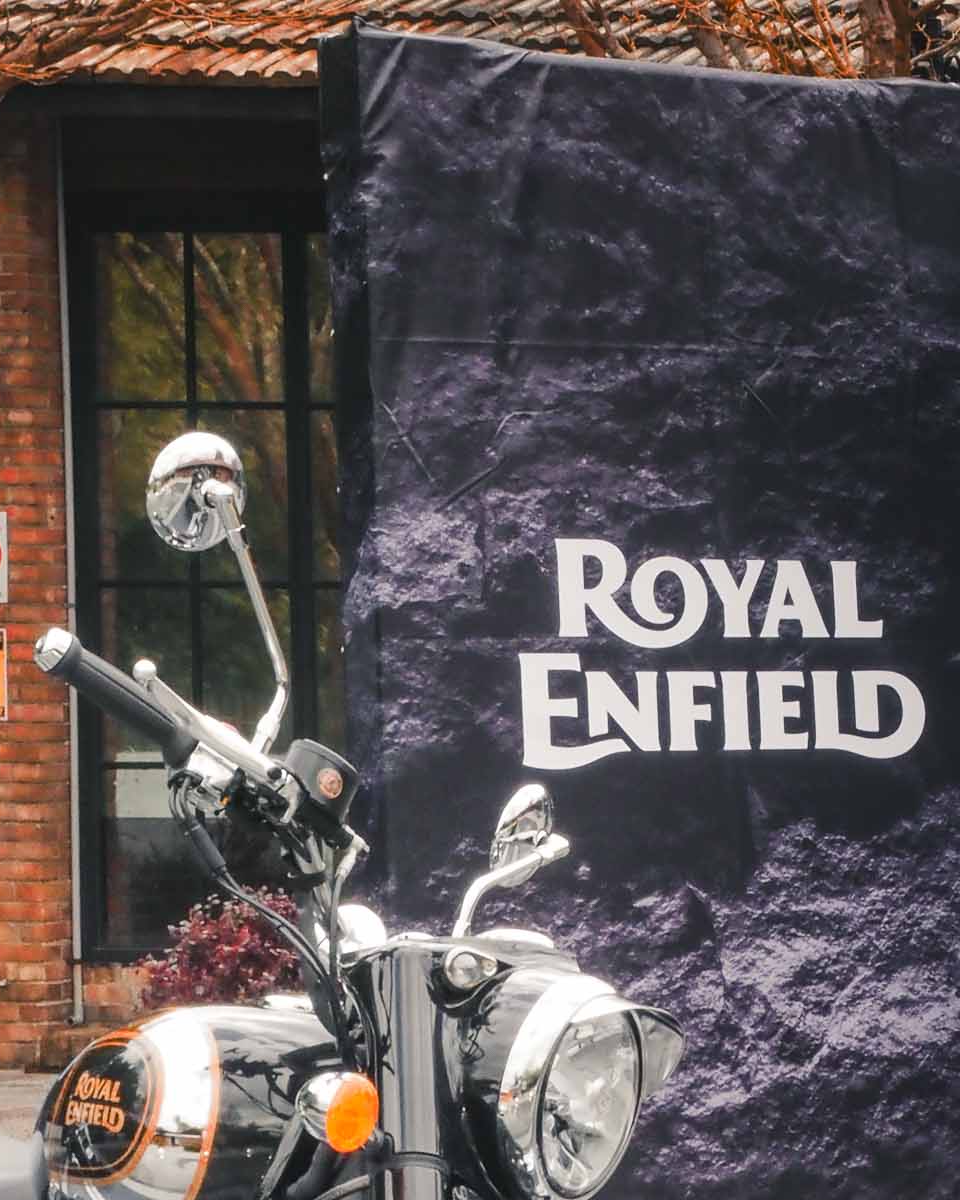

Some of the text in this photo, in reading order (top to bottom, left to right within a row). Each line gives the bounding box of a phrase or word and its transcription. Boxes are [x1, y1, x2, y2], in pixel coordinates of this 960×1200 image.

[555, 538, 884, 648] ROYAL
[519, 653, 926, 770] ENFIELD
[65, 1101, 125, 1133] ENFIELD
[74, 1071, 122, 1102] ROYAL
